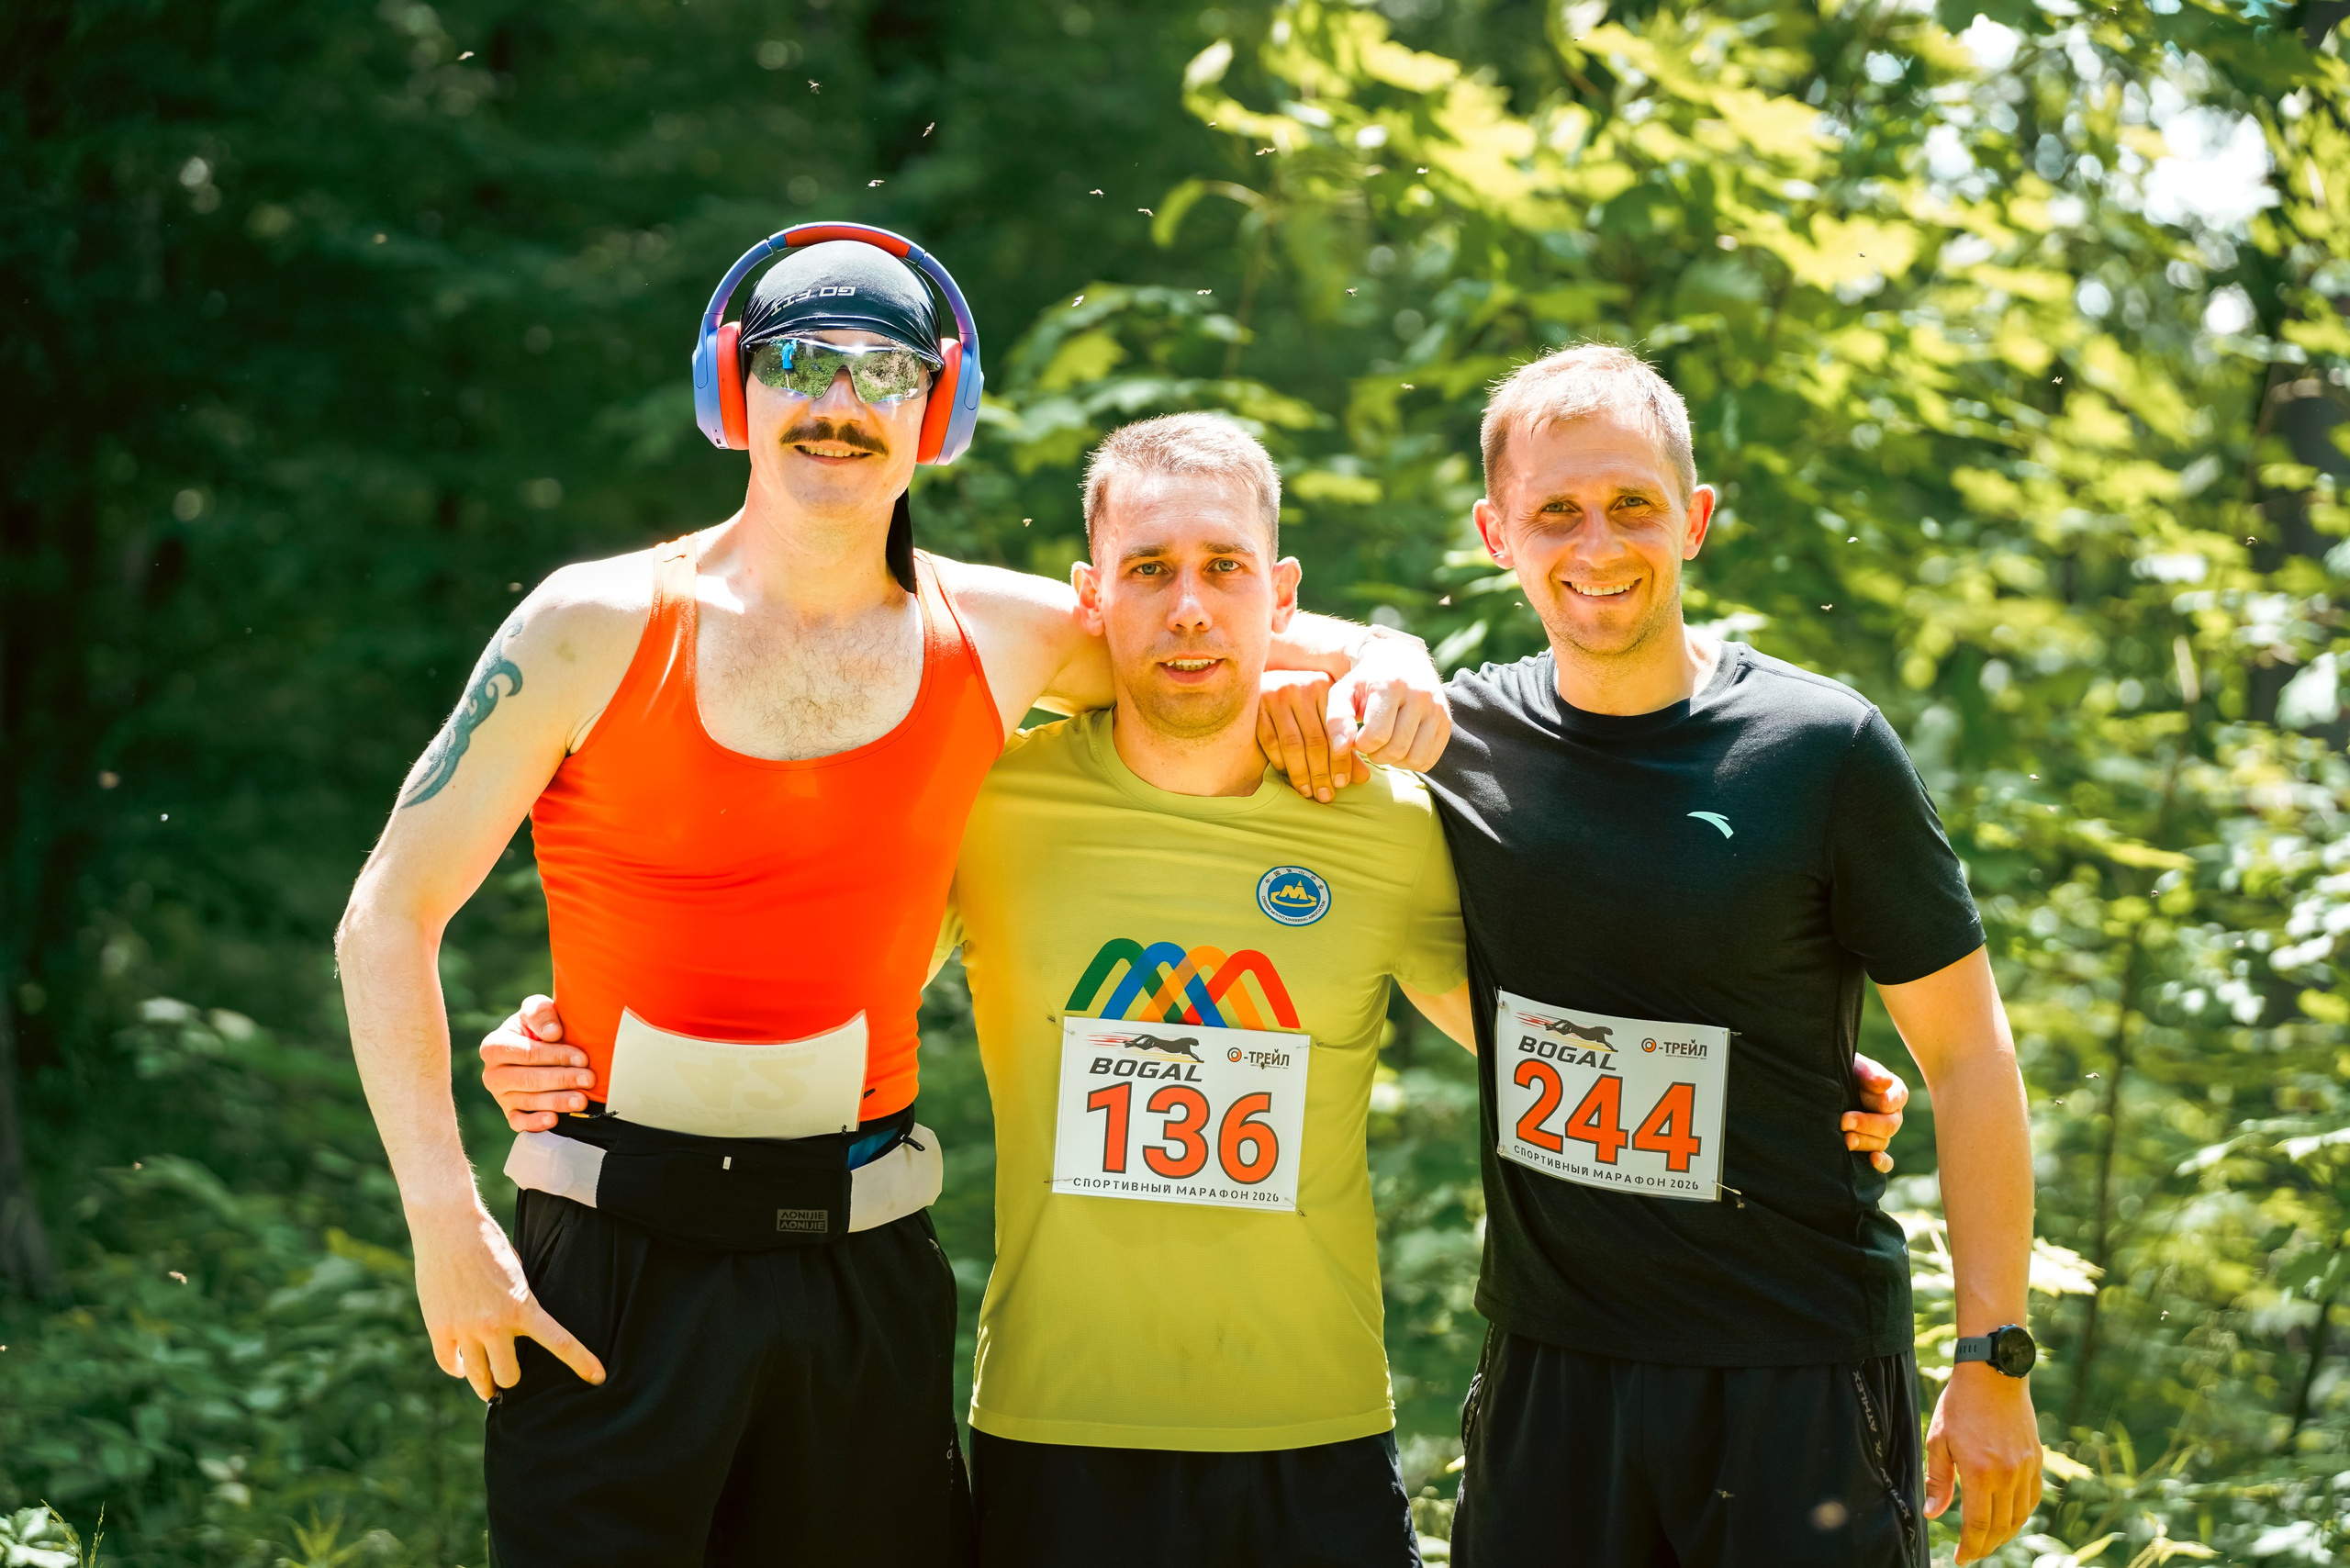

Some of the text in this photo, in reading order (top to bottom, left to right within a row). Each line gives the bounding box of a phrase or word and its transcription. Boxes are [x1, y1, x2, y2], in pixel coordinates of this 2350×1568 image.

[819, 286, 856, 297] GO
[1089, 1057, 1203, 1082] BOGAL
[1517, 1035, 1617, 1071] BOGAL
[1087, 1081, 1280, 1185] 136
[1514, 1058, 1702, 1174] 244
[1514, 1145, 1699, 1191] СПОРТИВНЫЙ МАРАФОН 2026
[1073, 1176, 1280, 1203] СПОРТИВНЫЙ МАРАФОН 2026
[1852, 1370, 1878, 1433] ATHLEX
